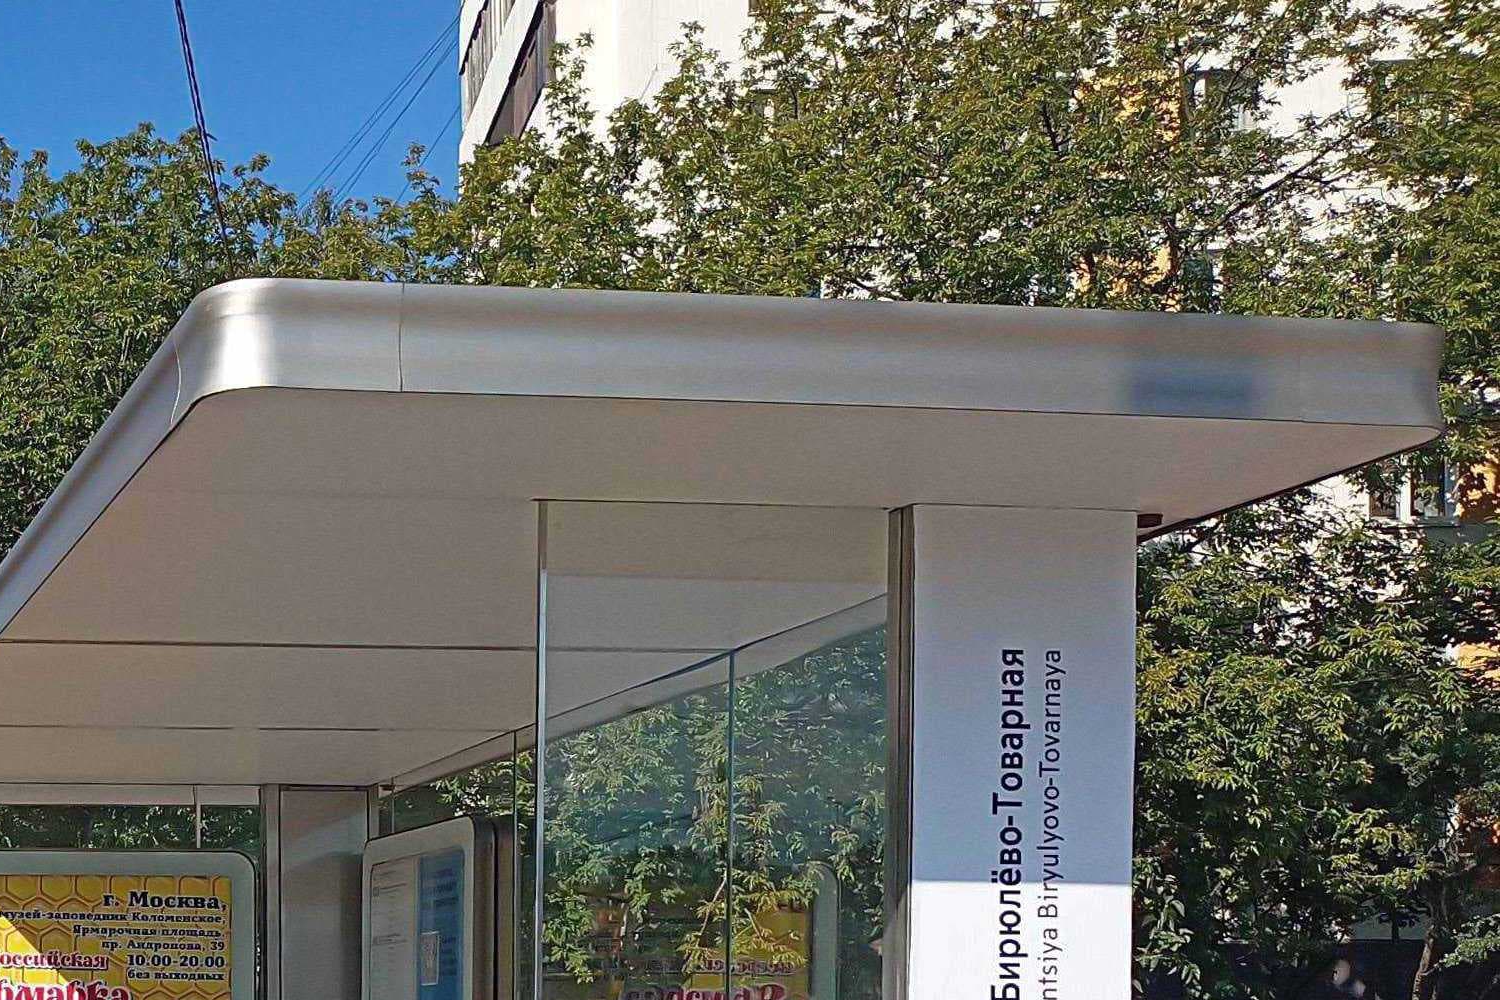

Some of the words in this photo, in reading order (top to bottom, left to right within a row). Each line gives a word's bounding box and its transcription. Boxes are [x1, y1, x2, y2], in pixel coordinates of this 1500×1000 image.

[1036, 649, 1067, 919] Biryulyovo-Tovarnaya
[102, 894, 120, 907] г.
[128, 891, 227, 911] Москва,
[0, 910, 127, 922] музей-заповедник
[132, 912, 226, 925] Коломенское,
[73, 924, 156, 938] Ярмарочная
[102, 940, 123, 950] пр.
[128, 939, 205, 952] Андропова,
[210, 939, 225, 951] 39
[128, 970, 150, 981] без
[154, 973, 225, 982] выходных
